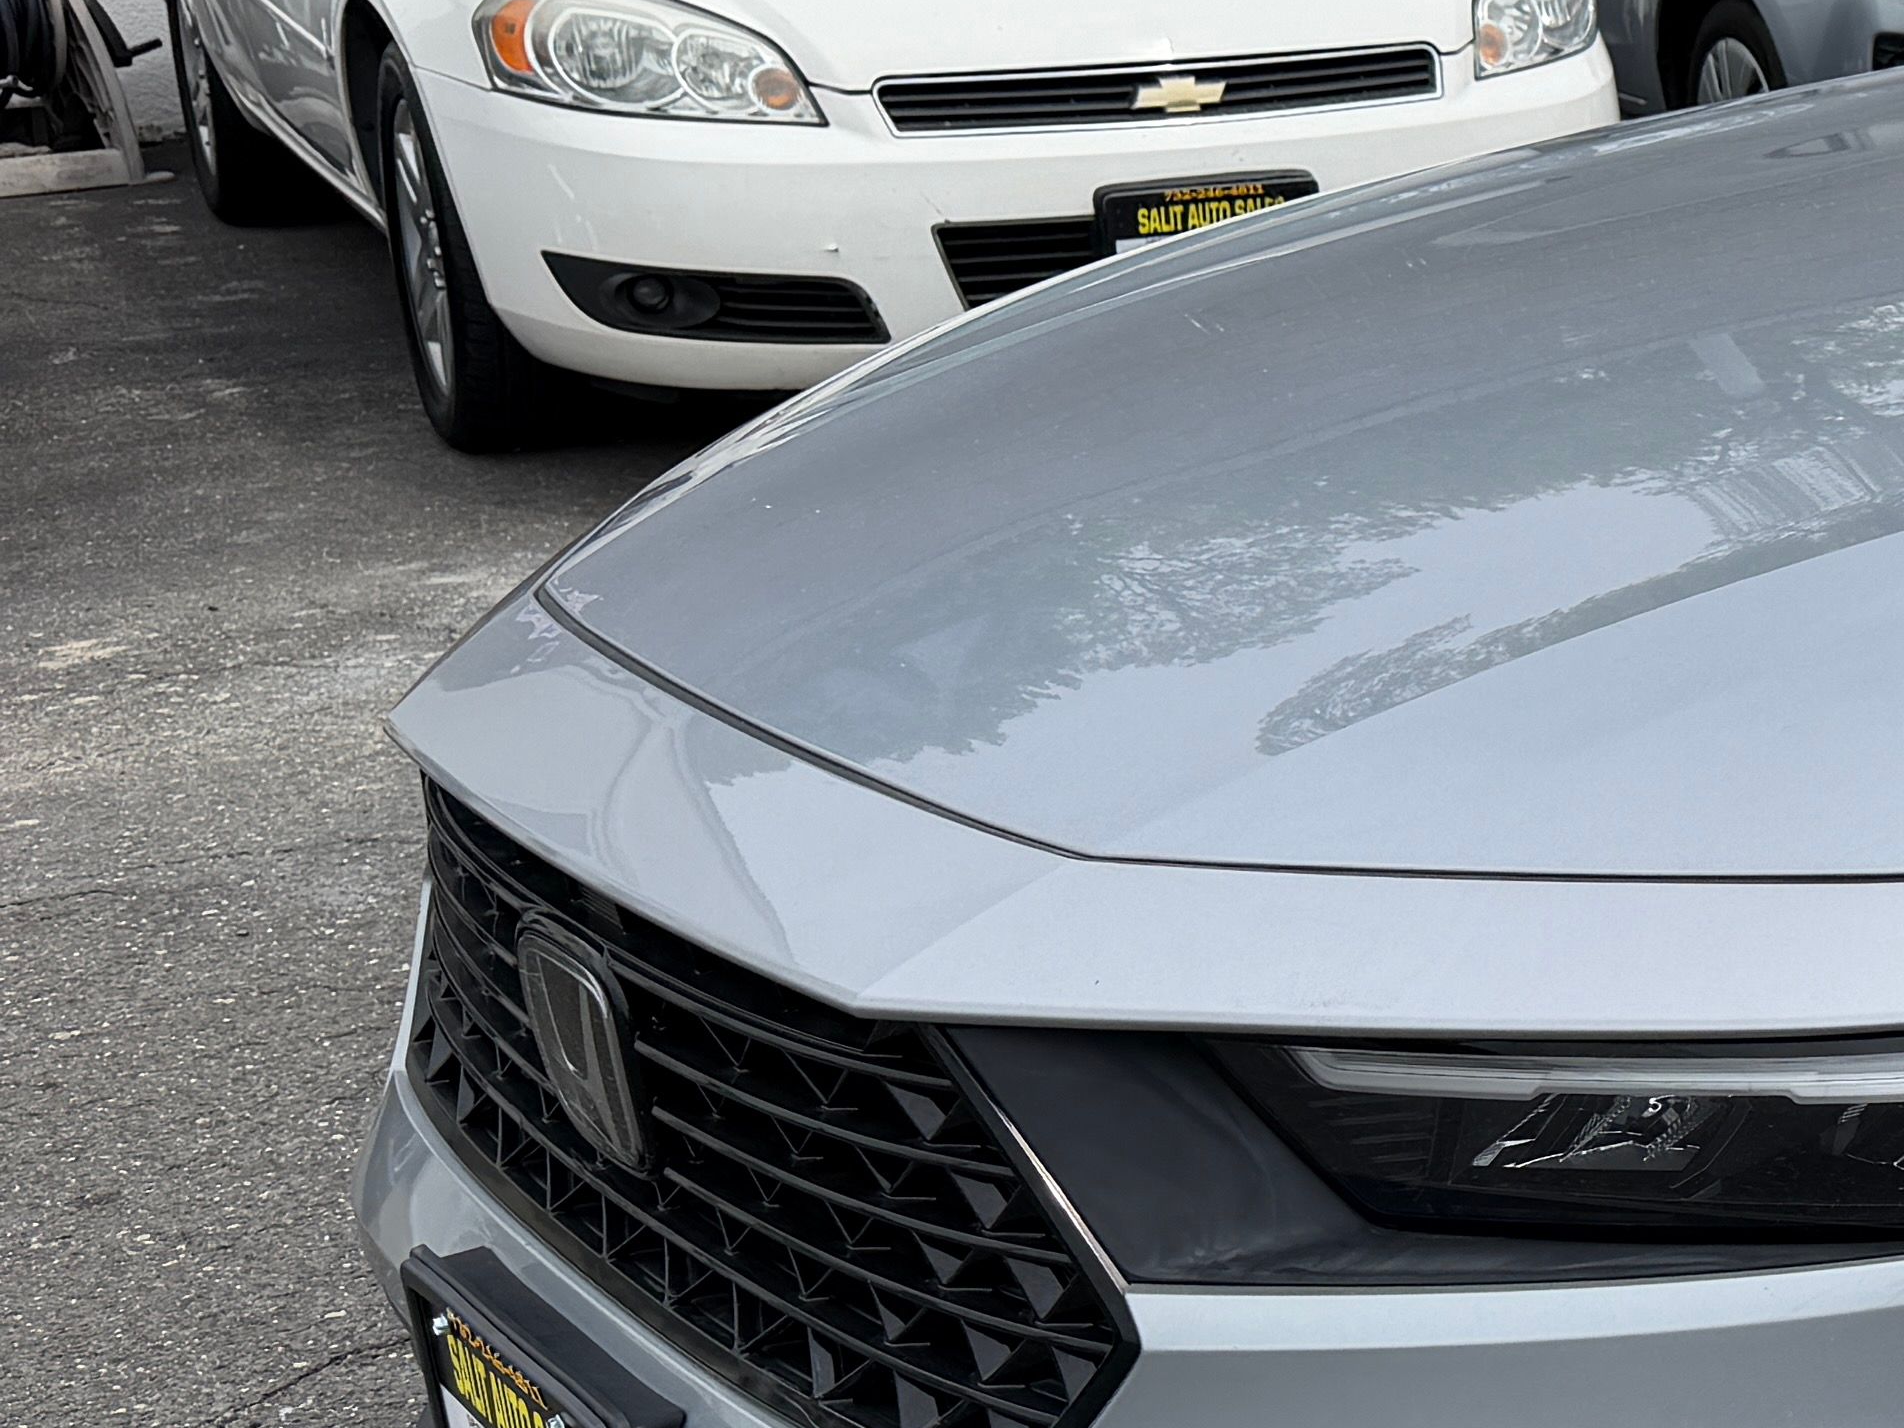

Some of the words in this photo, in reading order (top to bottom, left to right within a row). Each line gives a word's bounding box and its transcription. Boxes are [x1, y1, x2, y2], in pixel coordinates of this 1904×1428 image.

[1137, 205, 1184, 235] SALIT
[1187, 200, 1231, 230] AUTO
[447, 1334, 493, 1424] SALIT
